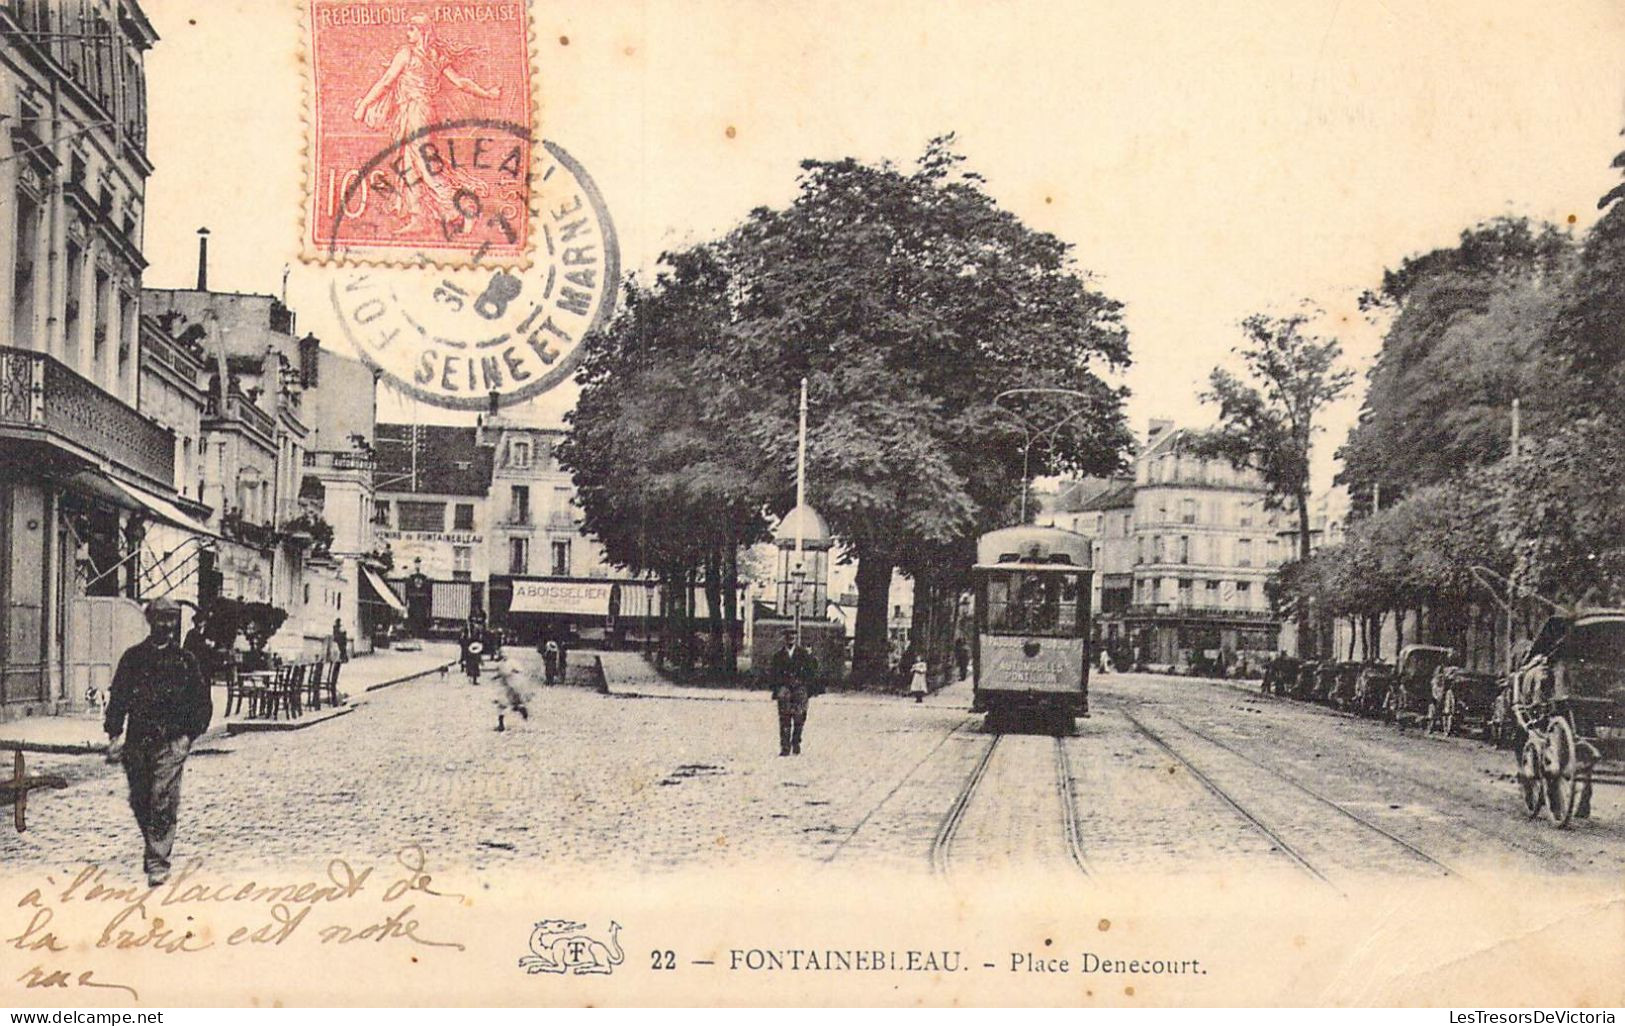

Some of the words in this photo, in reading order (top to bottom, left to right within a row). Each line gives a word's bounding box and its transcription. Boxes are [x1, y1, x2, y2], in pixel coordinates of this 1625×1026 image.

[414, 346, 531, 391] SEINE
[527, 316, 573, 366] ET
[551, 194, 597, 317] MARNE
[382, 844, 465, 904] de
[6, 907, 69, 951] la
[226, 903, 311, 946] est
